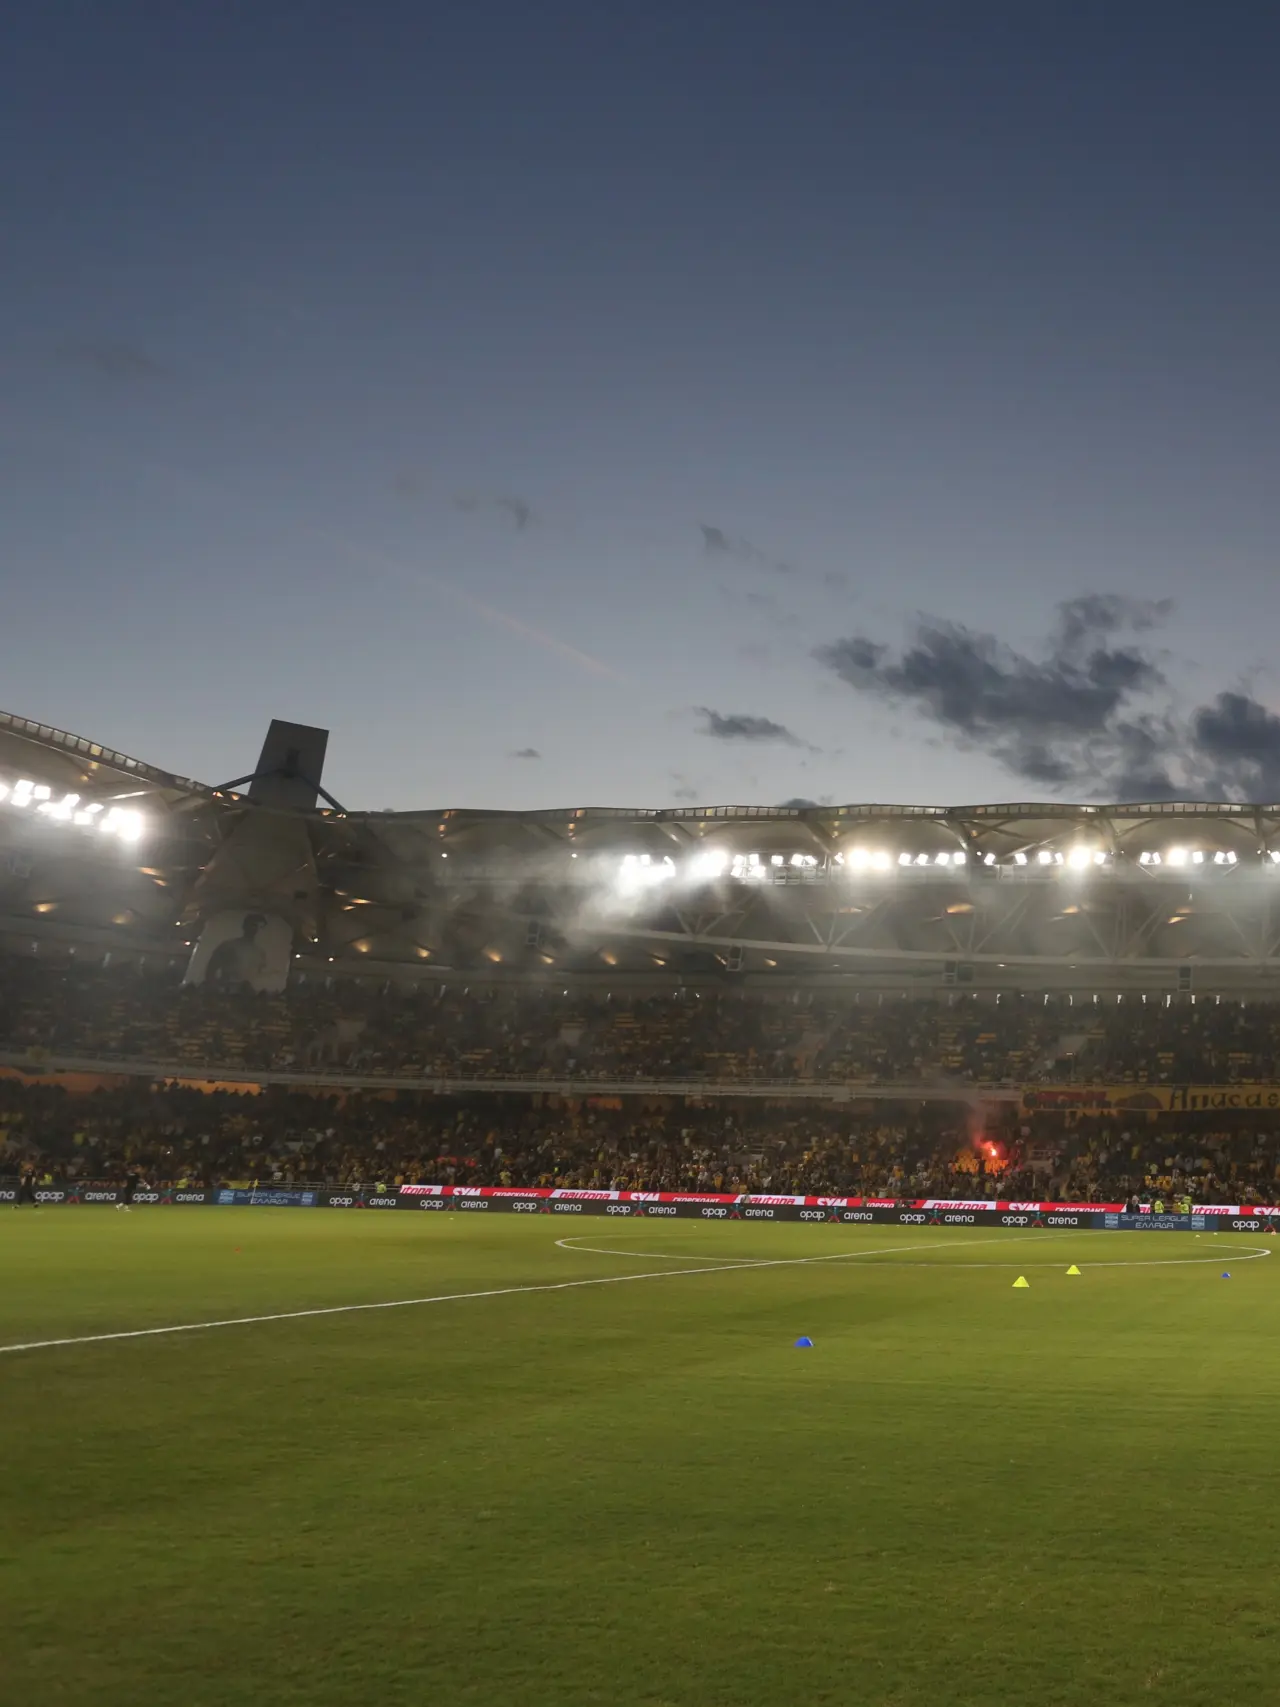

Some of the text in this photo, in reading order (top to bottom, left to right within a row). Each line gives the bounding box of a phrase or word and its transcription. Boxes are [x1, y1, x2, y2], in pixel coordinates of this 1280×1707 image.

[34, 1191, 117, 1203] opap arena
[132, 1192, 205, 1204] opap arena
[329, 1196, 397, 1207] opap arena
[419, 1199, 489, 1210] opap arena
[512, 1201, 582, 1212] opap arena
[606, 1205, 677, 1216] opap arena
[701, 1207, 774, 1218] opap arena
[799, 1210, 873, 1221] opap arena
[899, 1213, 975, 1224] opap arena
[1001, 1215, 1078, 1227] opap arena
[1232, 1220, 1260, 1231] opap
